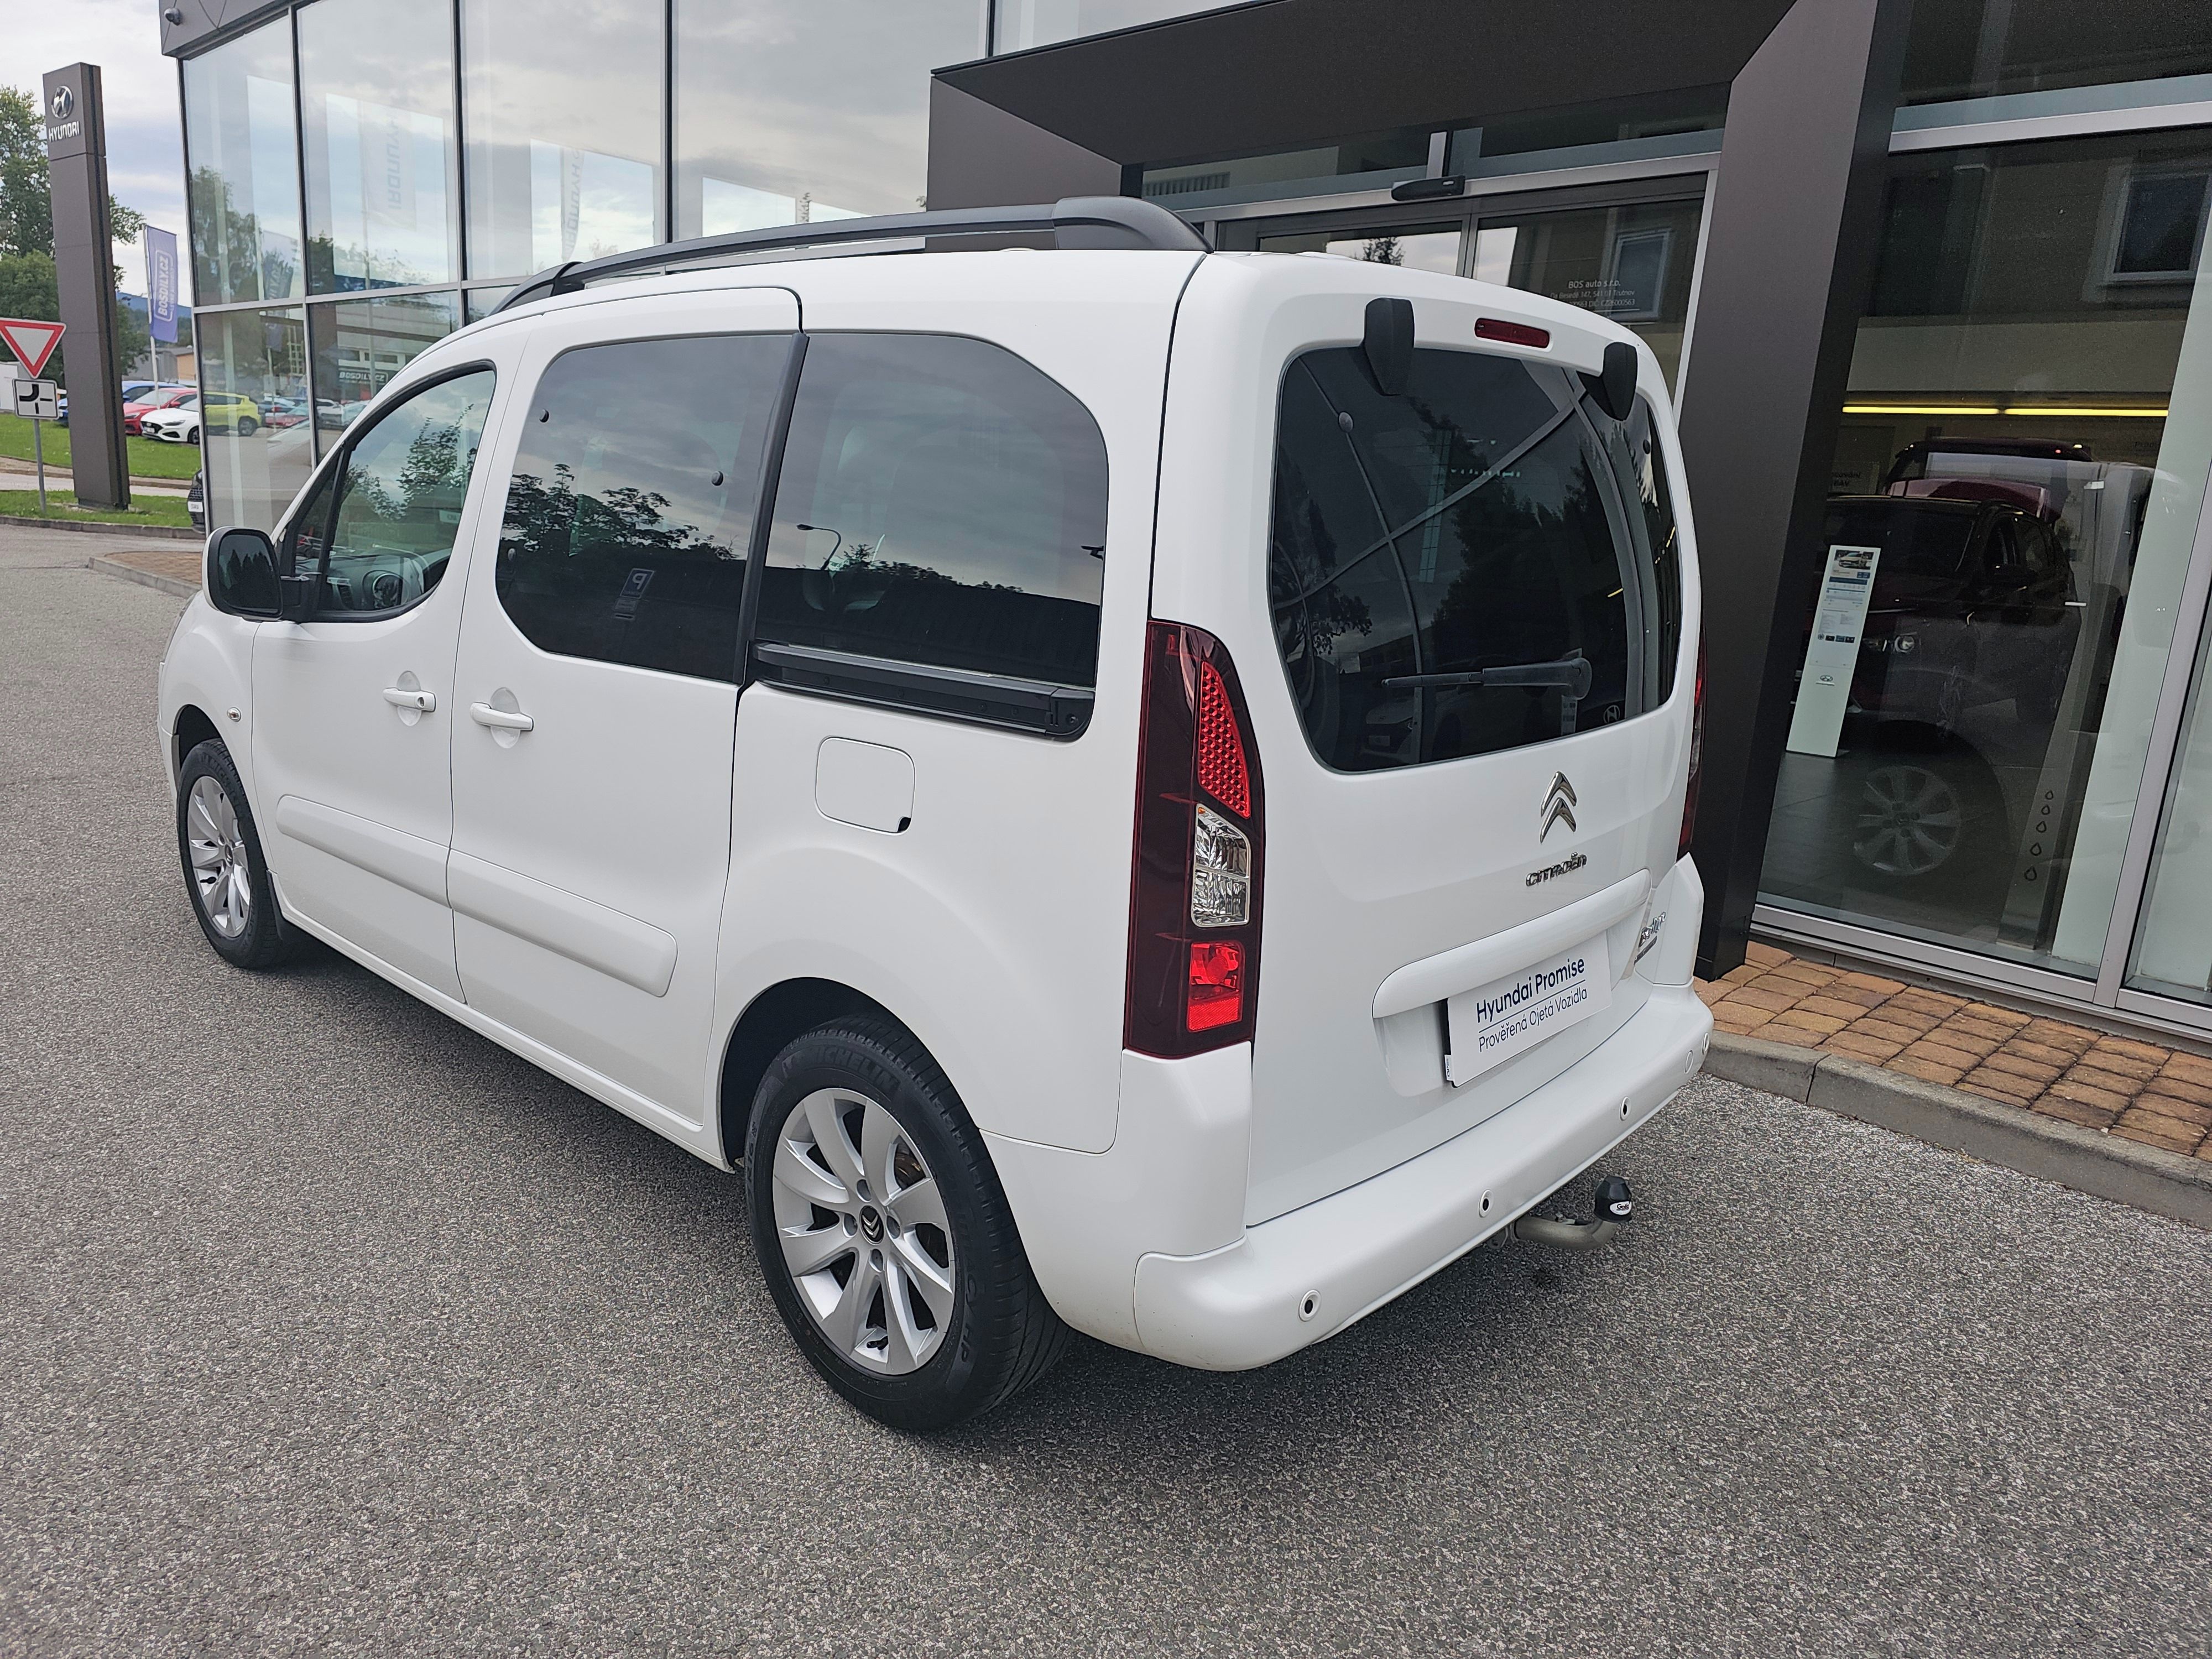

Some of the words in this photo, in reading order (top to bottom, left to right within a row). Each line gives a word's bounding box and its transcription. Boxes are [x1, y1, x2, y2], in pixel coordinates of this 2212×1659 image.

[48, 121, 80, 142] HYUNDAI
[158, 255, 169, 316] BOSDILY.CZ
[1568, 280, 1584, 289] BOS
[1585, 279, 1601, 288] auto
[1477, 977, 1532, 1023] Hyundai
[1535, 958, 1584, 994] Promise
[1479, 1014, 1527, 1053] Prověřená
[1529, 1000, 1553, 1027] Ojetá
[1555, 987, 1587, 1012] Vozidla
